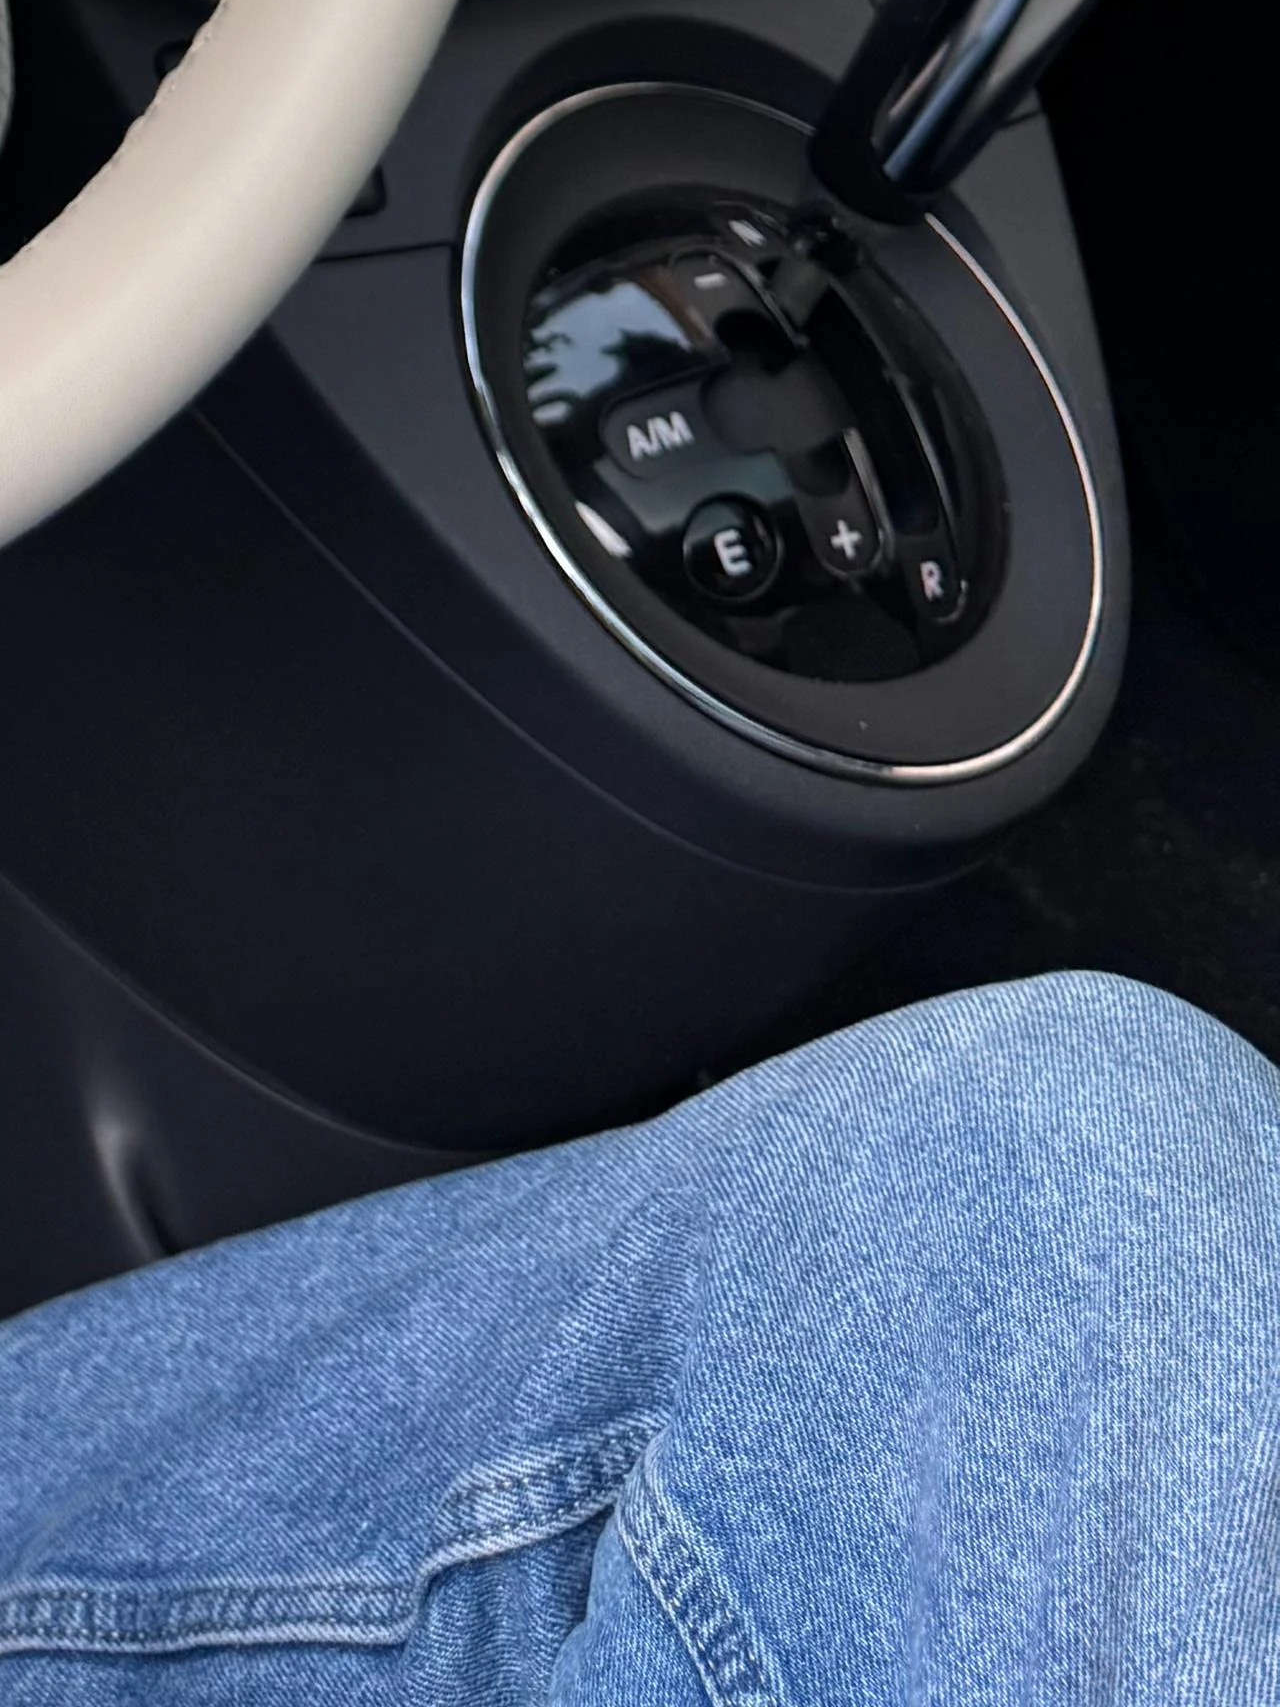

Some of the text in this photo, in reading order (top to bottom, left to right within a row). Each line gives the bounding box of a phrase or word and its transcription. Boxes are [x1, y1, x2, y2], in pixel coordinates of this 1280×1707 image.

[627, 410, 695, 462] A/M
[713, 528, 751, 578] E
[919, 560, 941, 600] R
